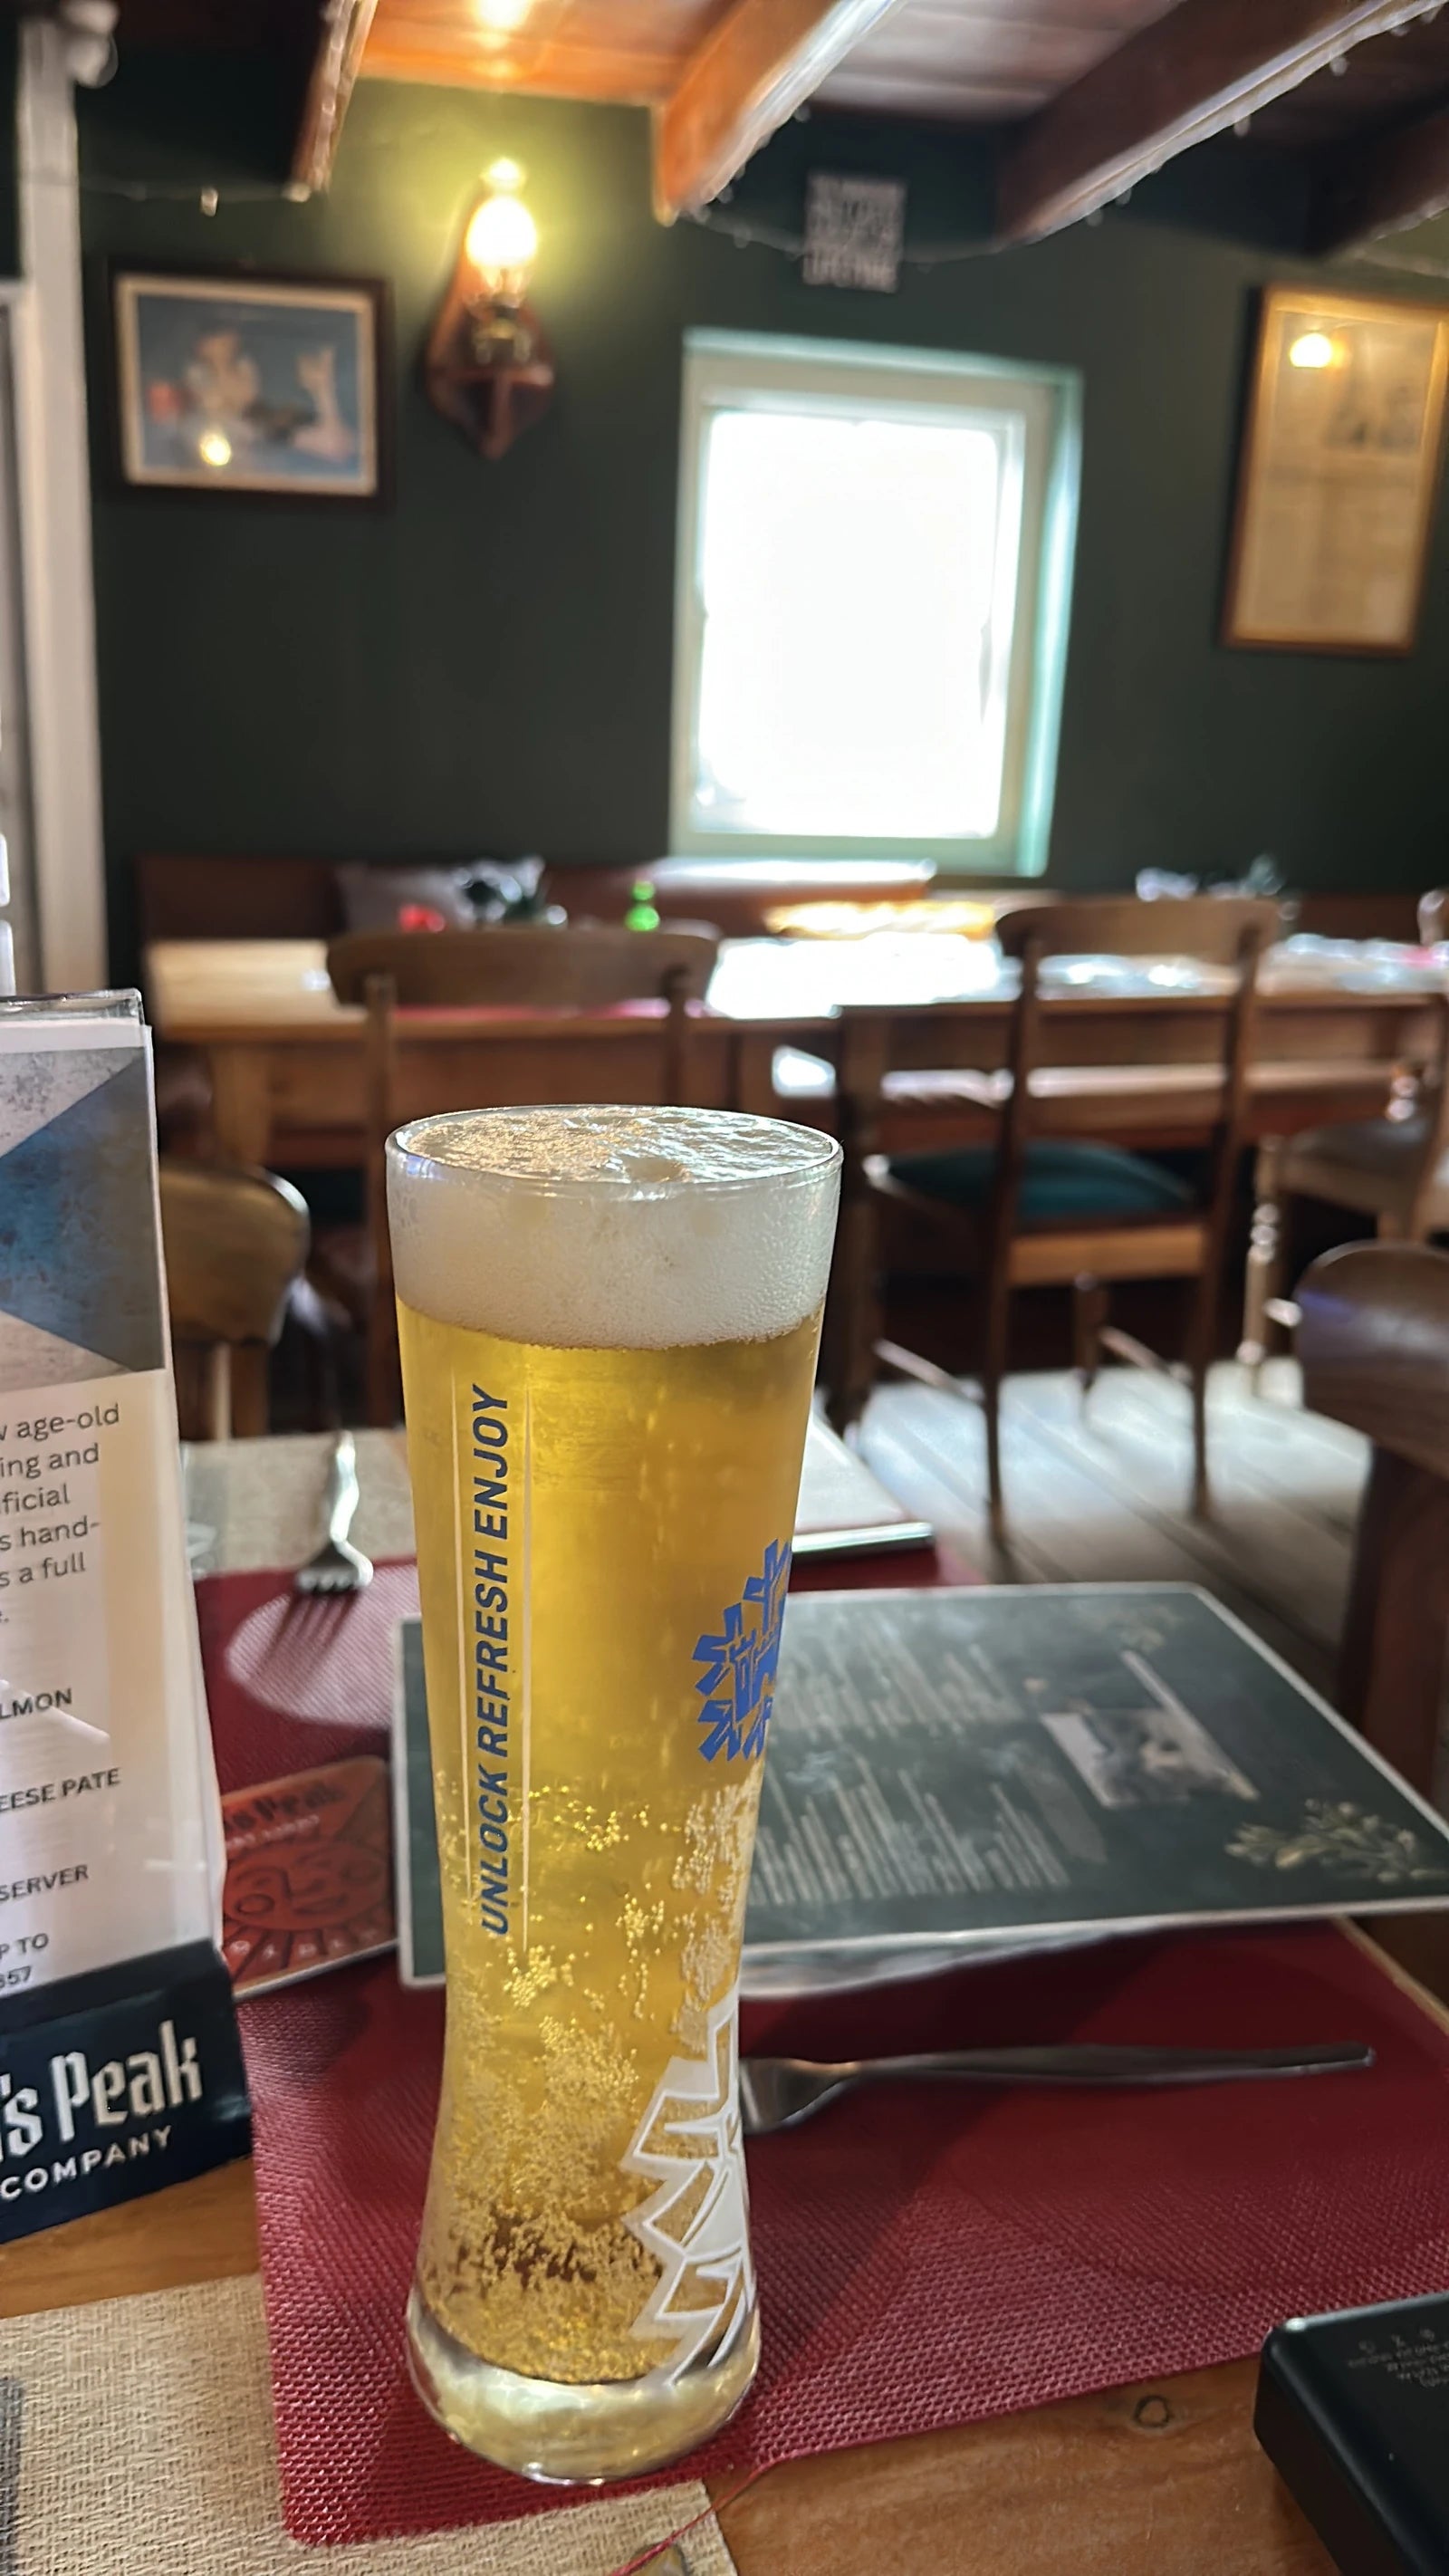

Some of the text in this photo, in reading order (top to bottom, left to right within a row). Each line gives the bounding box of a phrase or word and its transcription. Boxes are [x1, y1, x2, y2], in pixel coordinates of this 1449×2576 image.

[16, 1402, 120, 1441] age-old
[49, 1442, 100, 1471] and
[20, 1515, 101, 1548] hand-
[18, 1566, 34, 1584] a
[42, 1551, 86, 1580] full
[472, 1382, 511, 1937] UNLOCK REFRESH ENJOY
[62, 1767, 120, 1798] PATE
[0, 1863, 90, 1903] SERVER
[16, 1932, 50, 1954] TO
[49, 2018, 204, 2144] Peak
[0, 2124, 173, 2203] COMPANY
